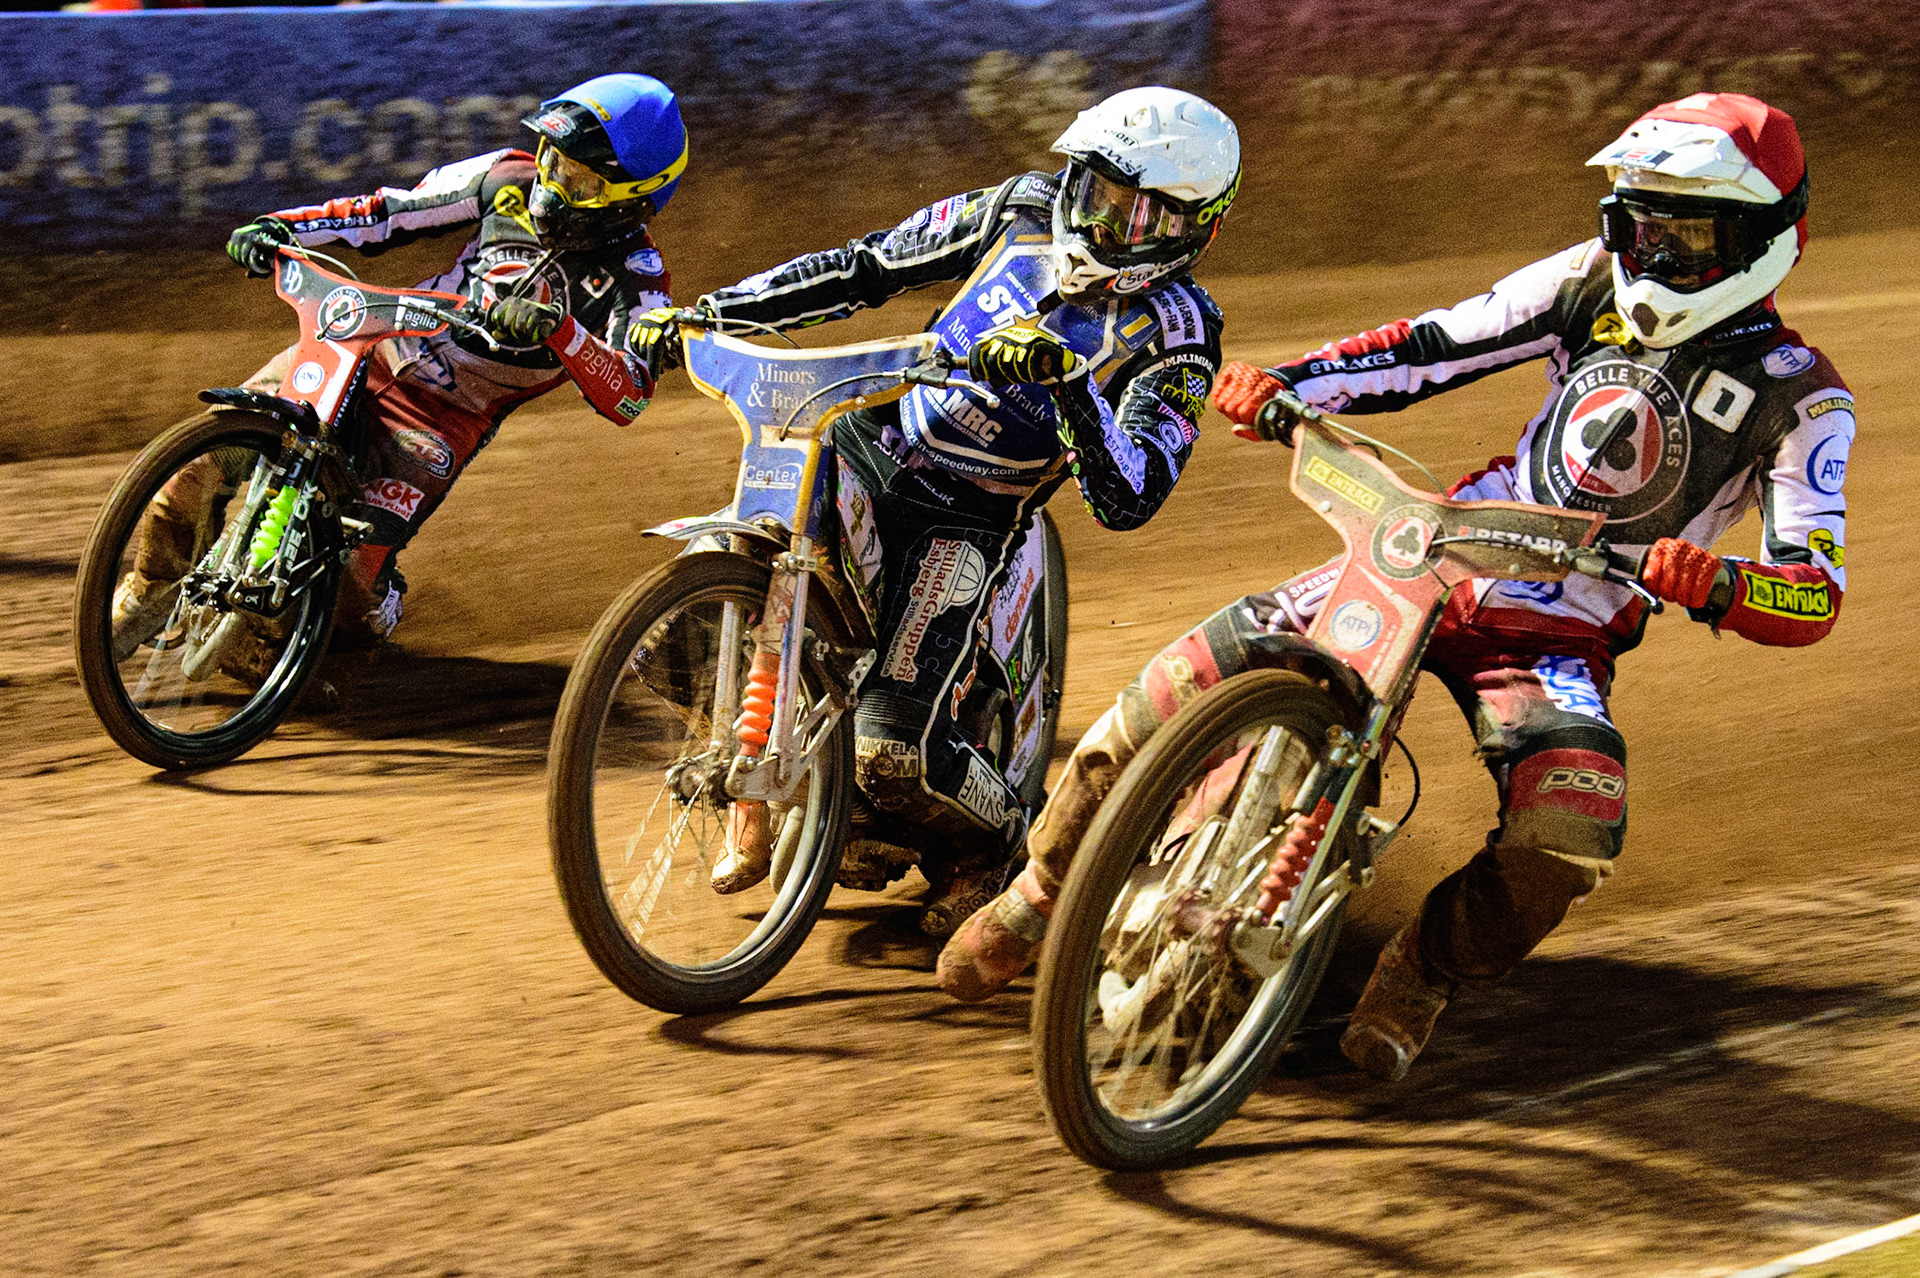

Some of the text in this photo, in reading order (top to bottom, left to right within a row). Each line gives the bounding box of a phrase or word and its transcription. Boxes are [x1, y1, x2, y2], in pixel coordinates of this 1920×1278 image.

[486, 250, 531, 266] BELLE
[404, 309, 438, 330] agilia
[948, 316, 972, 351] Min
[580, 346, 623, 393] agilia
[757, 363, 816, 384] Minors
[747, 379, 767, 408] &
[1005, 384, 1051, 422] Brady
[942, 389, 1003, 442] MRC
[1575, 367, 1683, 469] BELLE VUE ACES
[745, 465, 798, 483] Centex
[911, 540, 947, 598] Esbjerg
[1289, 567, 1341, 599] SPEEDW
[897, 540, 963, 680] StilladsGruppen
[856, 736, 909, 756] NIKKEL
[1537, 767, 1625, 799] pod
